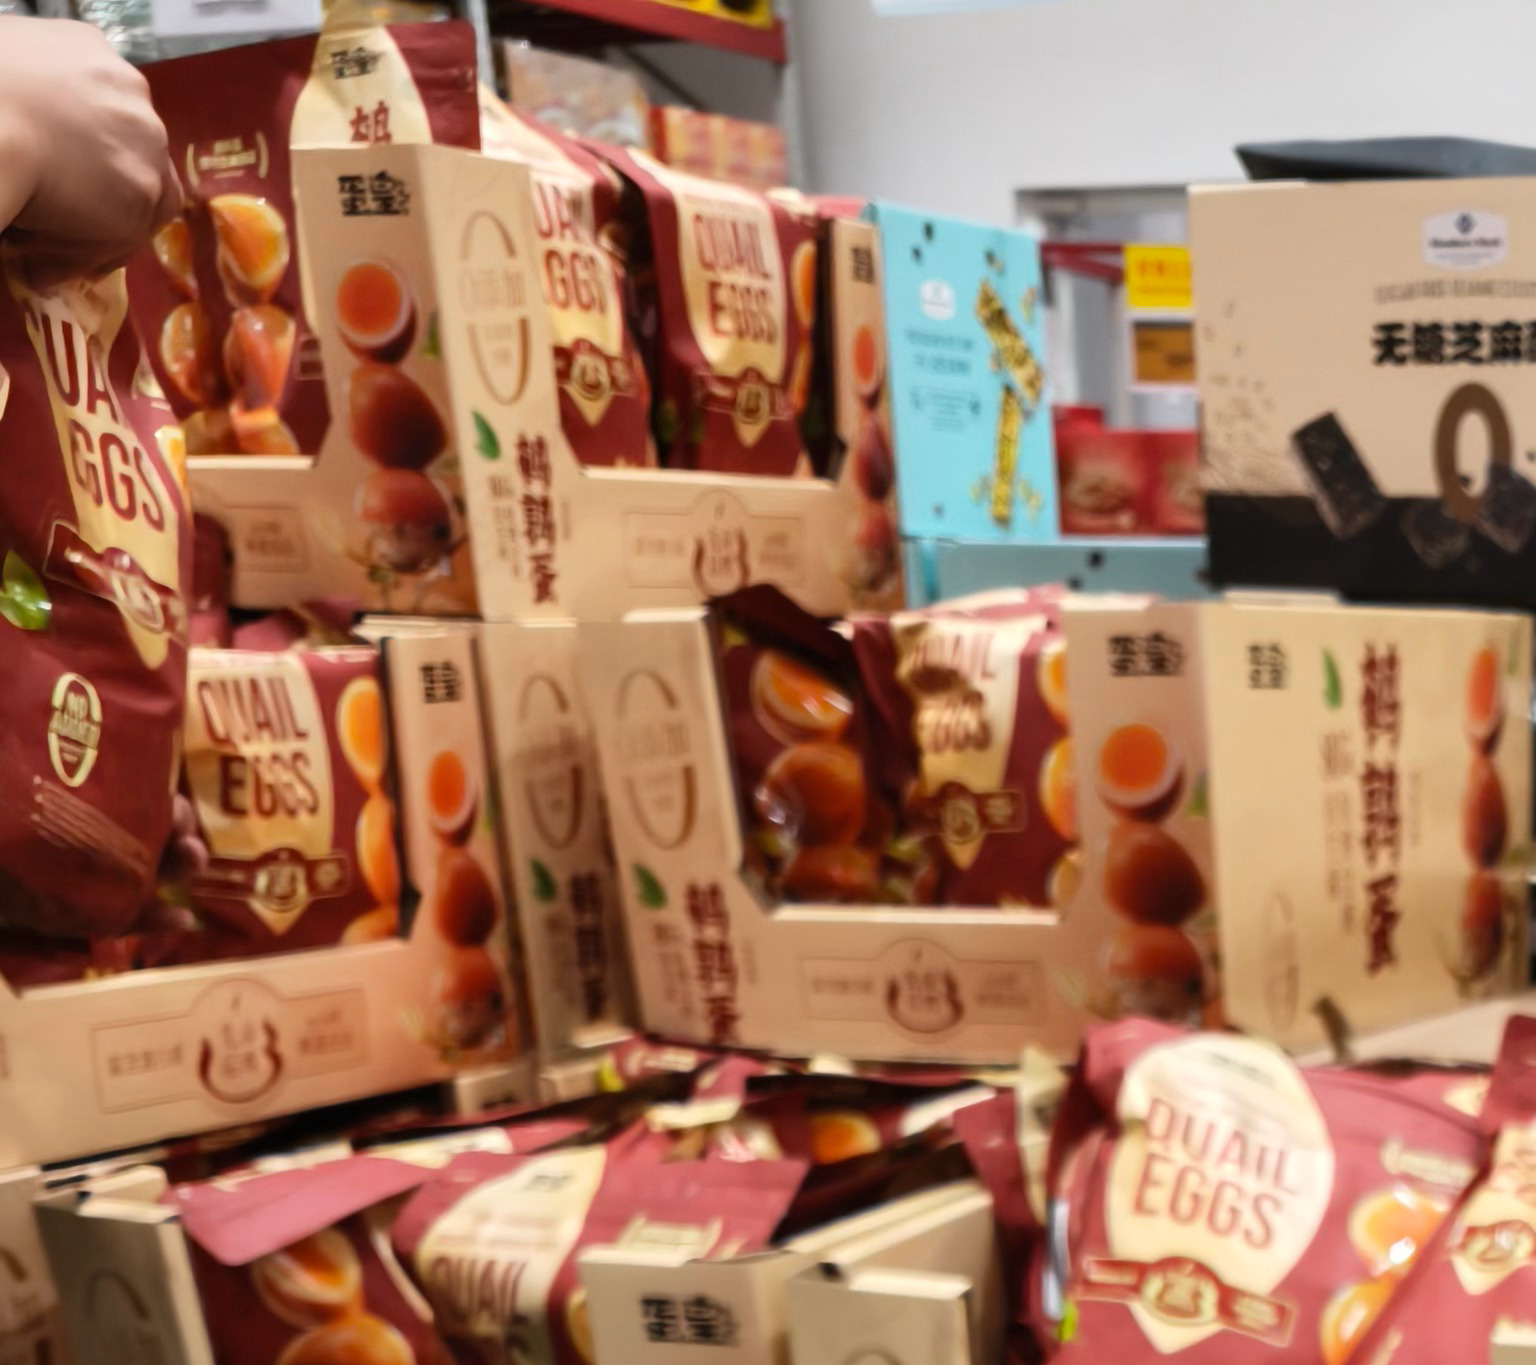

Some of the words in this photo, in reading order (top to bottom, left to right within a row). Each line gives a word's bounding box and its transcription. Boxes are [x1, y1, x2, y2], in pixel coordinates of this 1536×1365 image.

[70, 419, 164, 532] GGS
[1145, 1096, 1298, 1198] QUAIL
[1131, 1150, 1284, 1251] EGGS
